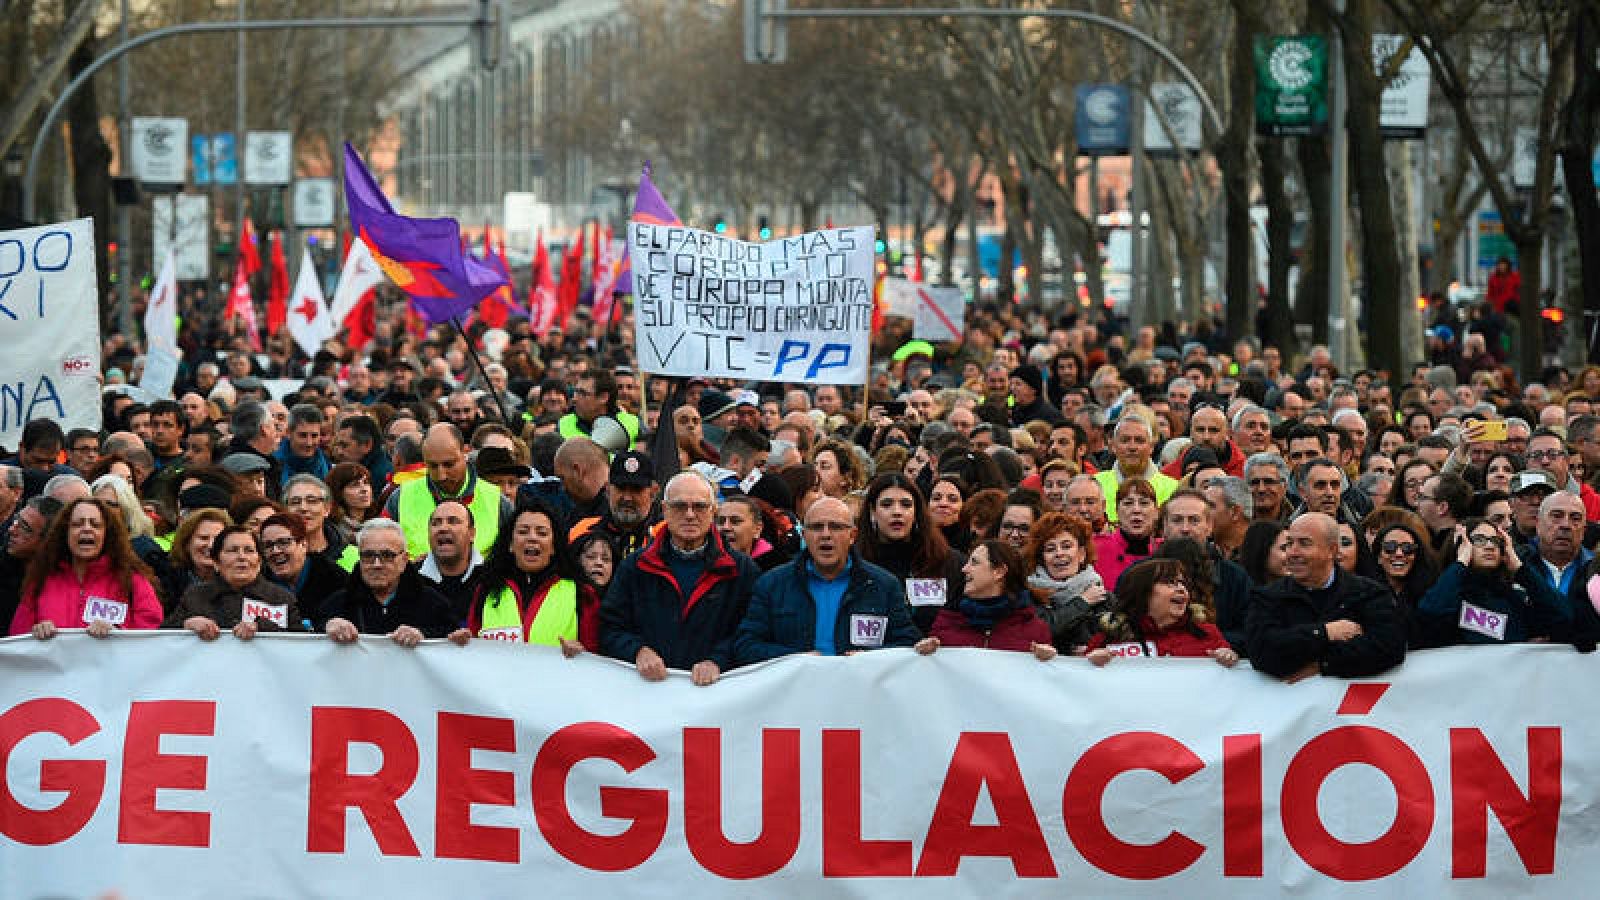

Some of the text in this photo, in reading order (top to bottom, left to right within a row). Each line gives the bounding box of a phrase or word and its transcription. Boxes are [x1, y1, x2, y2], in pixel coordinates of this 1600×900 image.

[635, 223, 856, 262] EL PARTIDO MAS
[638, 273, 870, 305] DE EUROPA MONTA
[641, 299, 675, 327] SU
[685, 303, 767, 333] PROPIO
[646, 330, 747, 371] VTC
[1, 373, 65, 433] NA
[0, 683, 1563, 882] GE REGULACIÓN
